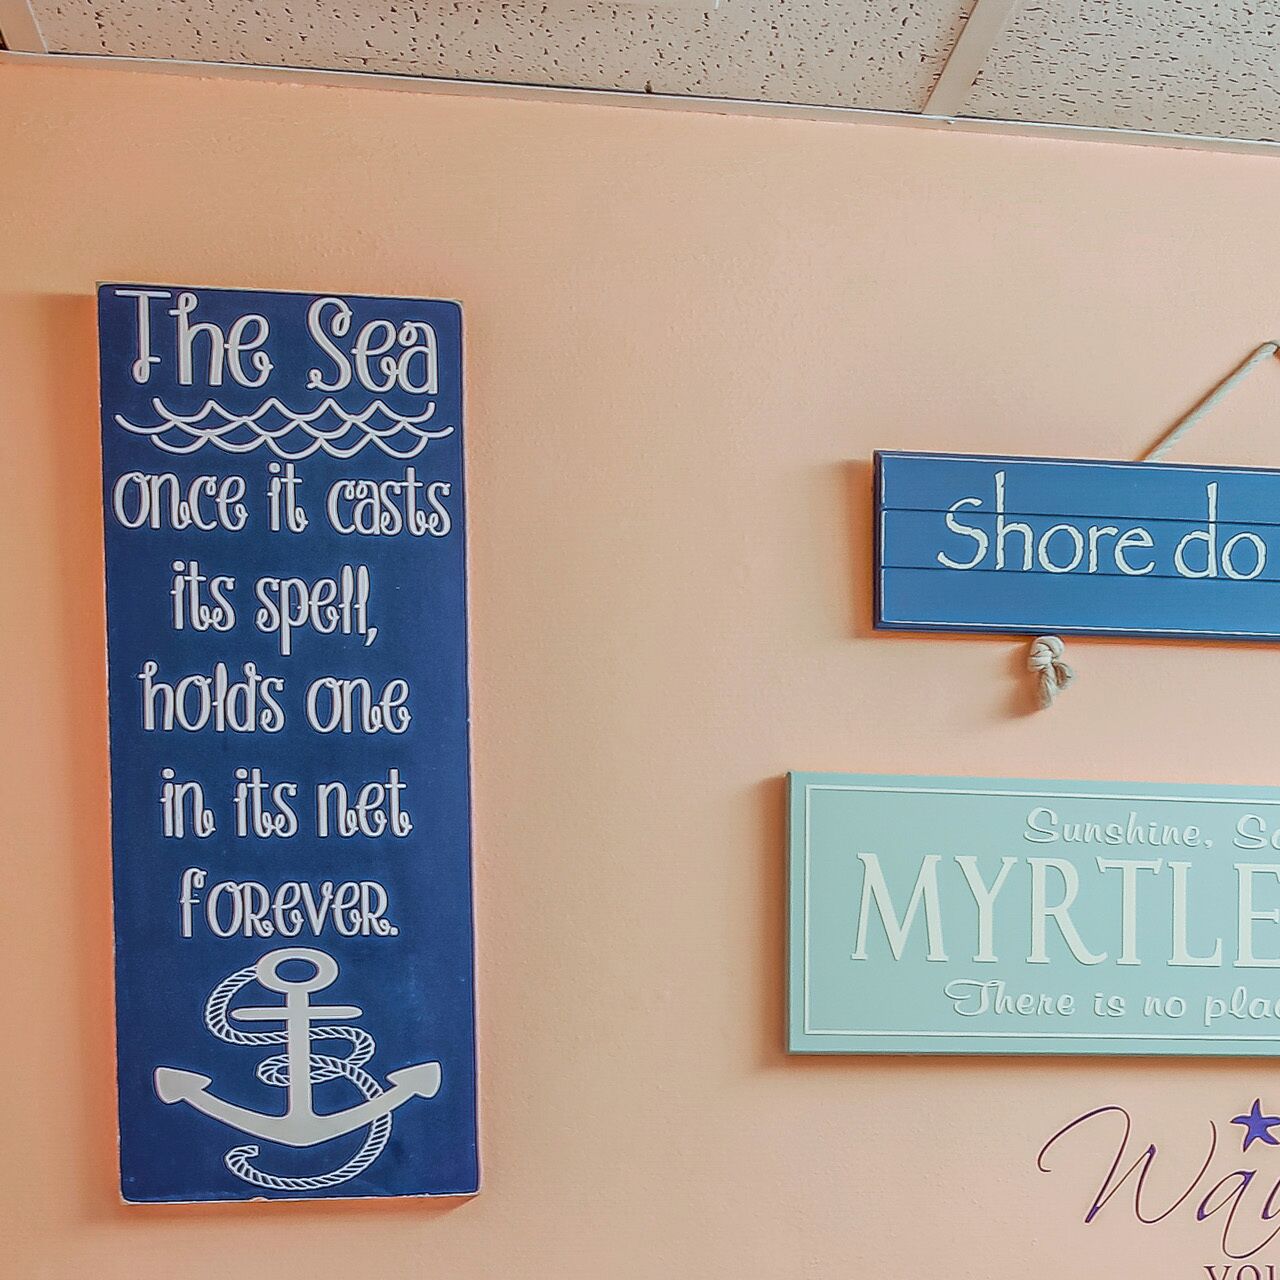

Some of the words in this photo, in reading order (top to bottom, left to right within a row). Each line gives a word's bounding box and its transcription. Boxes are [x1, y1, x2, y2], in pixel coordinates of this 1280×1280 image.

[115, 290, 274, 388] The
[306, 297, 438, 395] Sea
[115, 472, 249, 531] once
[267, 463, 309, 533] it
[328, 467, 452, 536] casts
[937, 471, 1155, 577] Shore
[1174, 482, 1266, 580] do
[171, 561, 236, 631] its
[257, 565, 378, 656] spell,
[139, 662, 285, 732] holds
[307, 678, 412, 733] one
[160, 769, 216, 838] in
[233, 769, 298, 838] its
[318, 769, 413, 837] net
[1022, 806, 1213, 849] Sunshine,
[944, 978, 1076, 1017] There
[1093, 990, 1125, 1018] is
[1143, 995, 1187, 1019] no
